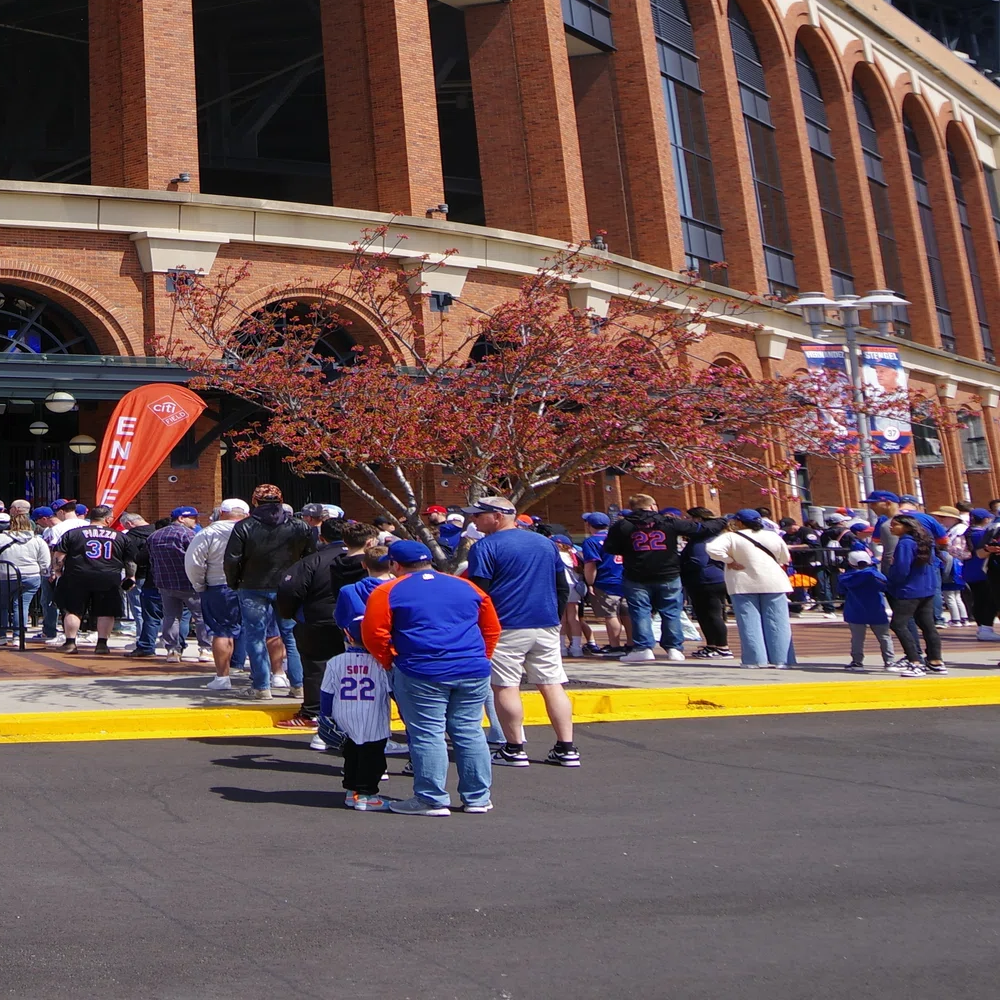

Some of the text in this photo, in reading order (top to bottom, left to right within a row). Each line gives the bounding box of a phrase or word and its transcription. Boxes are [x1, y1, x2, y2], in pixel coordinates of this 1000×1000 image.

[864, 351, 899, 361] STENGEL
[153, 402, 177, 414] citi
[165, 411, 187, 425] FIELD
[887, 428, 898, 437] 37
[101, 416, 137, 508] ENTE
[82, 528, 118, 540] PIAZZA
[631, 530, 667, 551] 22
[85, 539, 112, 560] 31
[346, 665, 369, 675] SOTO
[340, 676, 375, 701] 22
